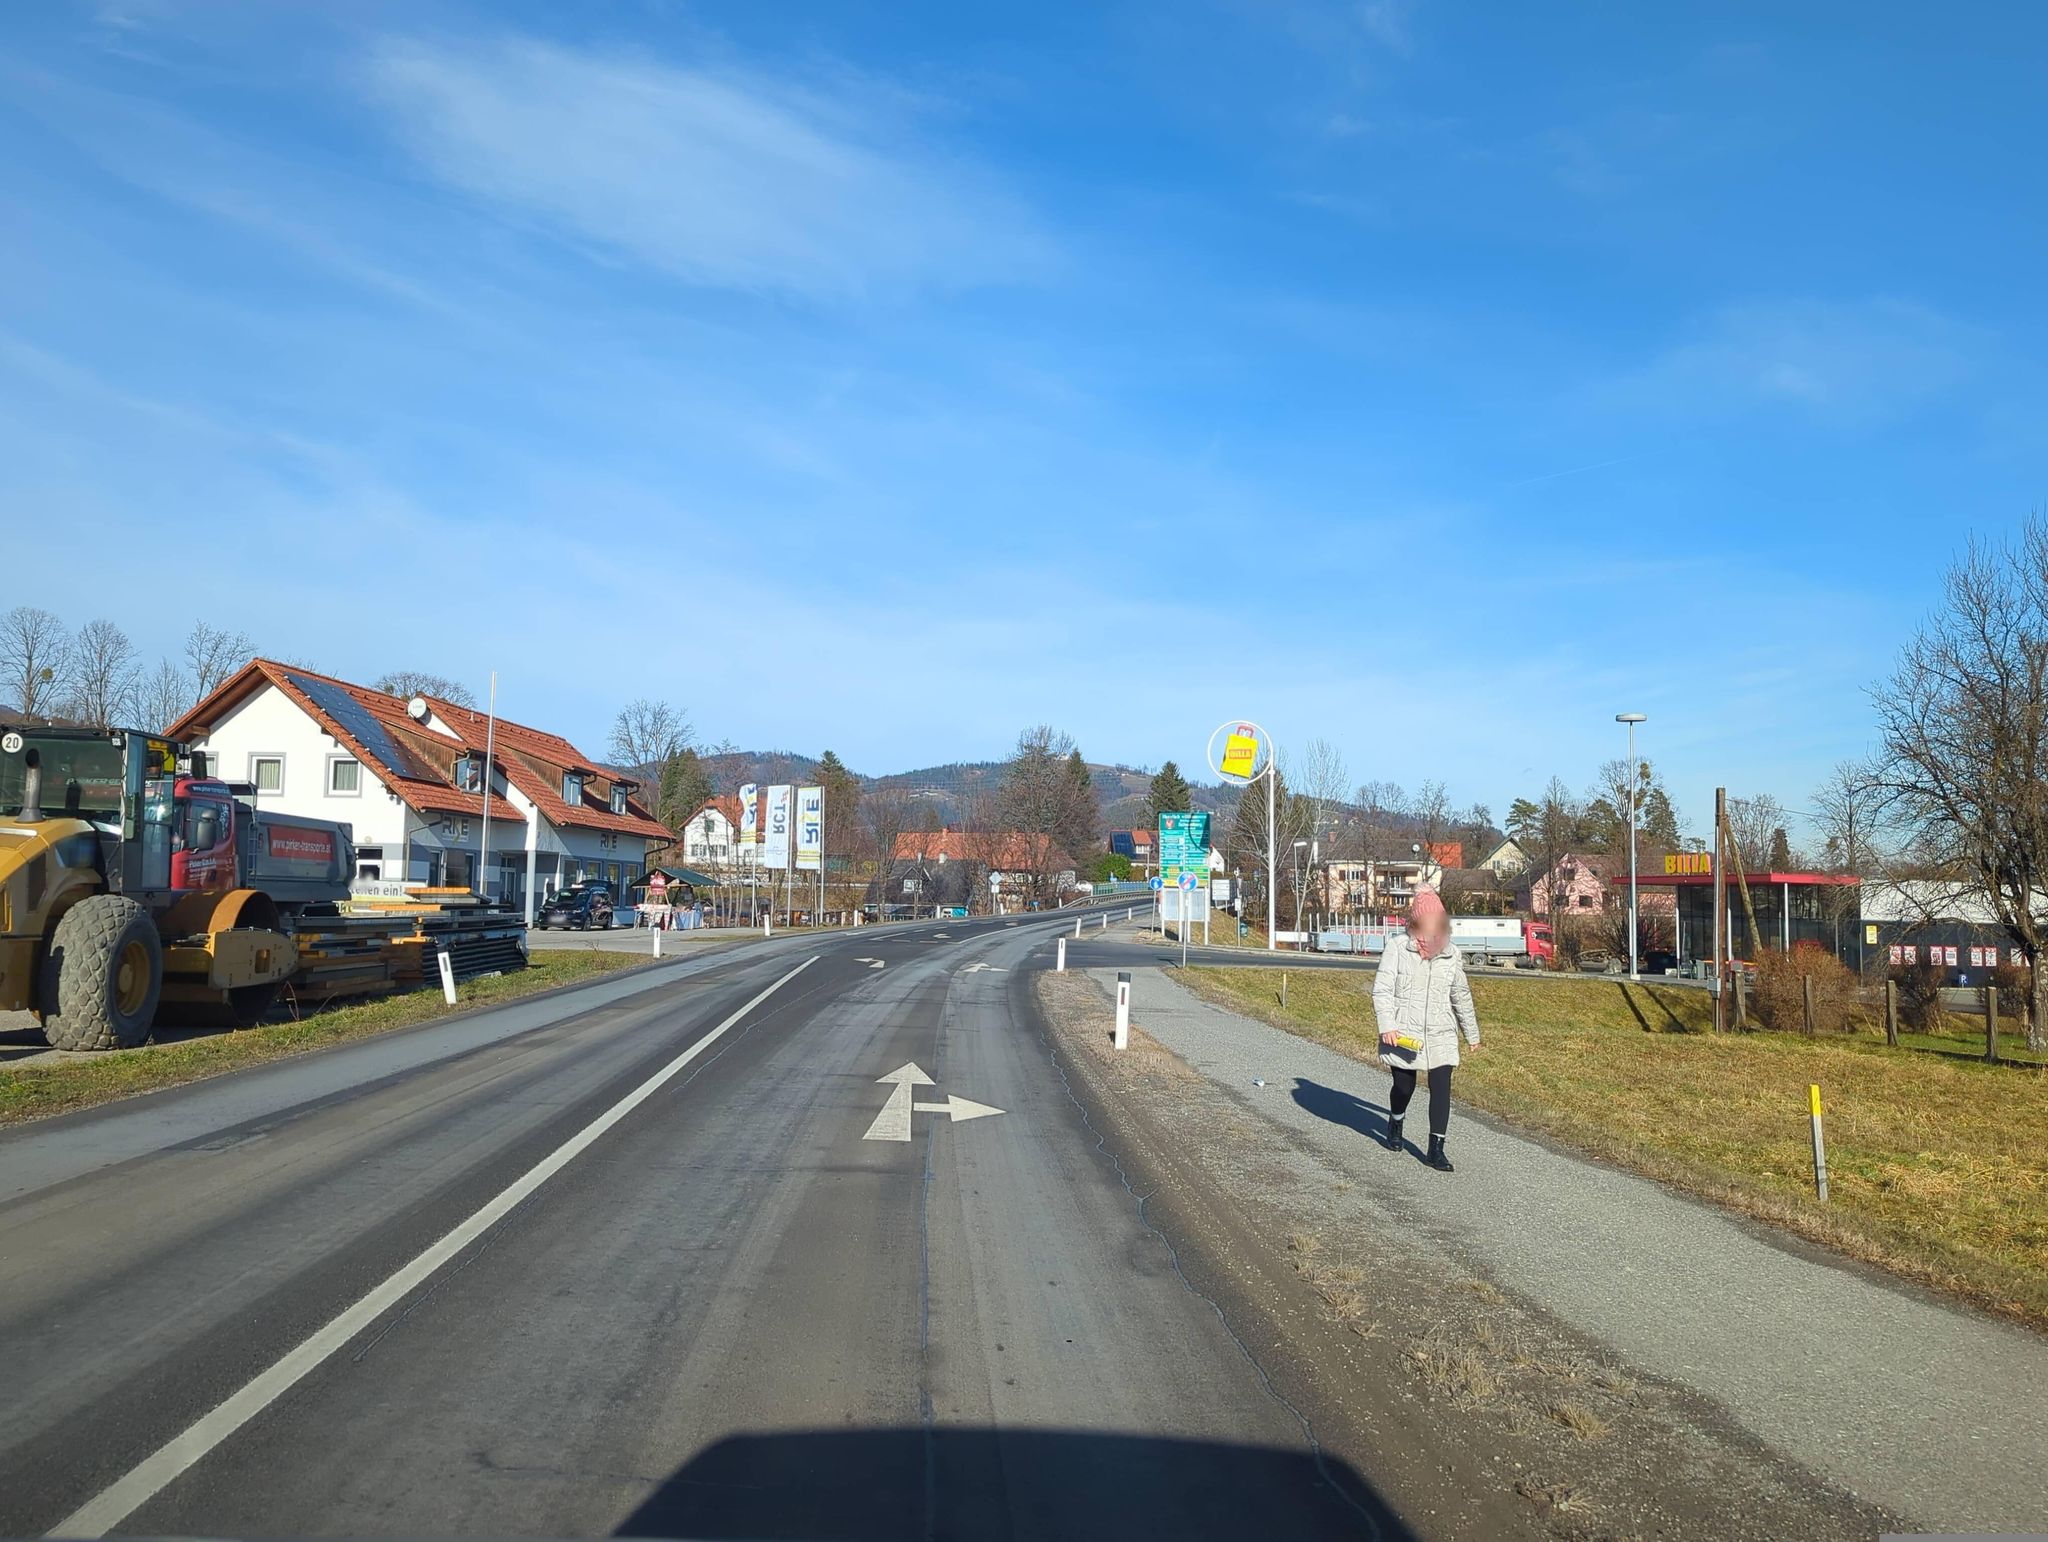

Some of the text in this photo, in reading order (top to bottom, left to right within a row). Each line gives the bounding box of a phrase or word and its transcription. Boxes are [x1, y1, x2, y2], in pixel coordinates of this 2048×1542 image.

[5, 736, 19, 749] 20
[600, 832, 617, 849] RIE
[1665, 853, 1712, 874] BILLA
[383, 883, 403, 898] ein!
